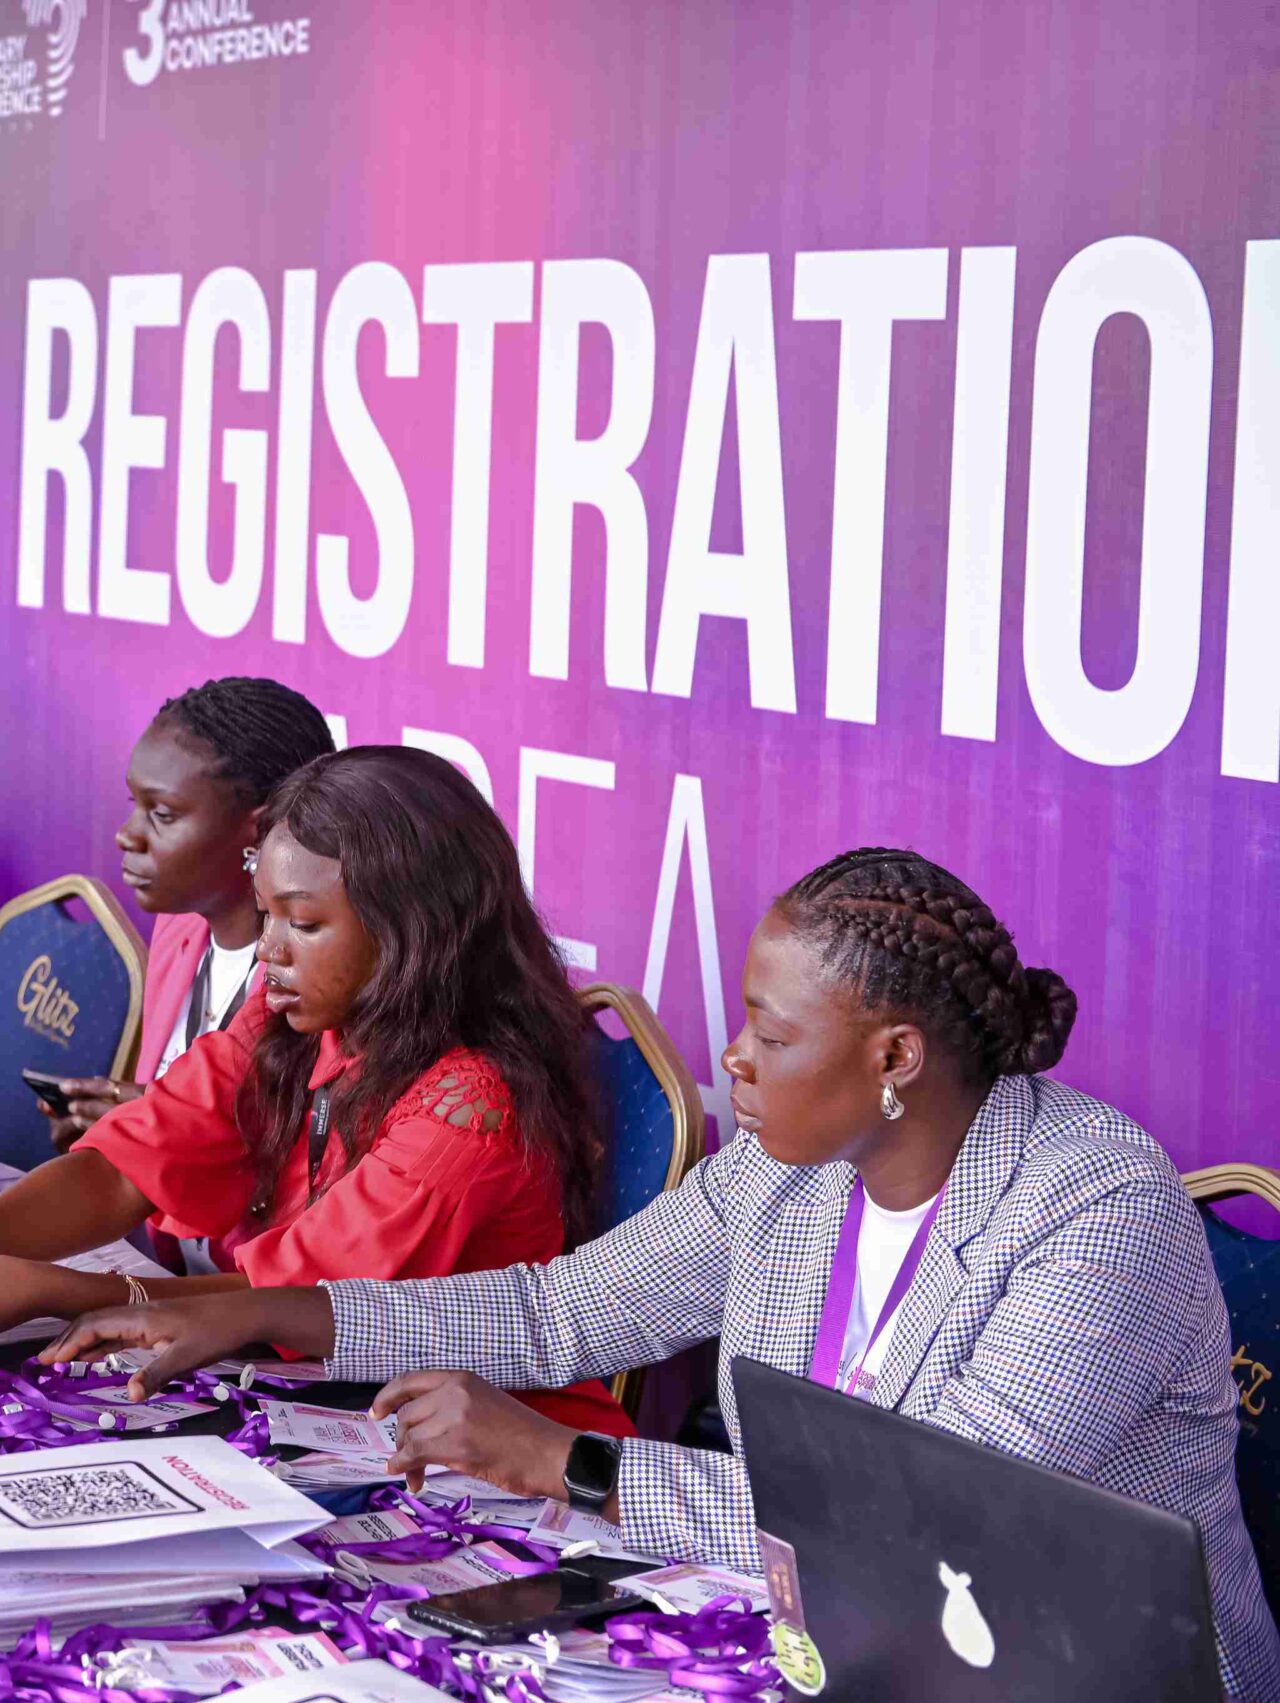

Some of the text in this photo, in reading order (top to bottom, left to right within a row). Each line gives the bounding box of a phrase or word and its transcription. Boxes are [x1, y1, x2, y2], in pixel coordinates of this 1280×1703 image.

[165, 18, 311, 71] CONFERENCE
[17, 955, 80, 1037] Glitz
[316, 1098, 328, 1136] IMMERSE
